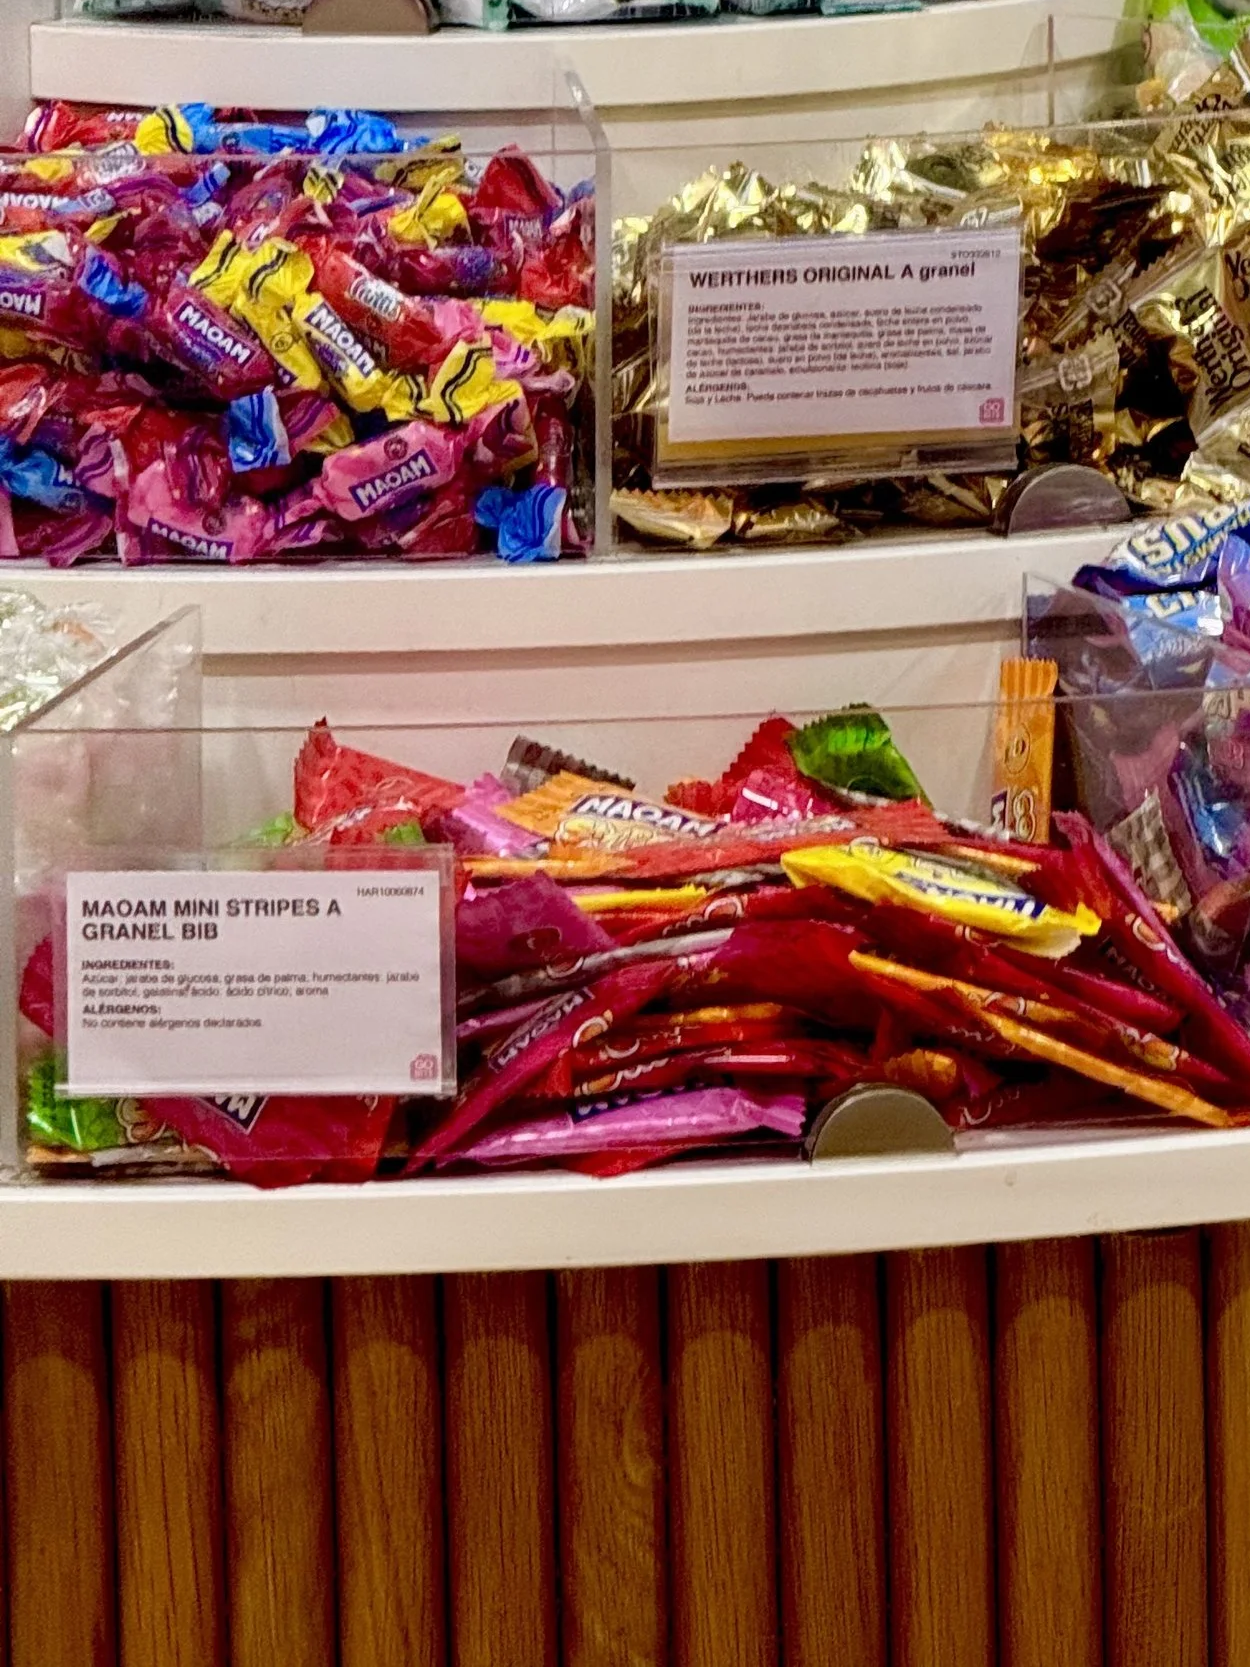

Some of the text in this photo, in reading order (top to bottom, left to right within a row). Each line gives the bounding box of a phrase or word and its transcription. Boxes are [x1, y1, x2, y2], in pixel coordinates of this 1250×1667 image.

[690, 261, 976, 289] WERTHERS ORIGINAL A granel
[178, 304, 251, 364] MAOAM
[311, 307, 376, 374] MAOAM
[355, 454, 432, 507] MAOAM
[150, 522, 229, 560] MAOAM
[576, 796, 718, 838] MAOAM
[81, 898, 342, 918] MAOAM MINI STRIPES A
[82, 922, 219, 942] GRANEL BIB
[81, 959, 175, 971] INGREDIENTES:
